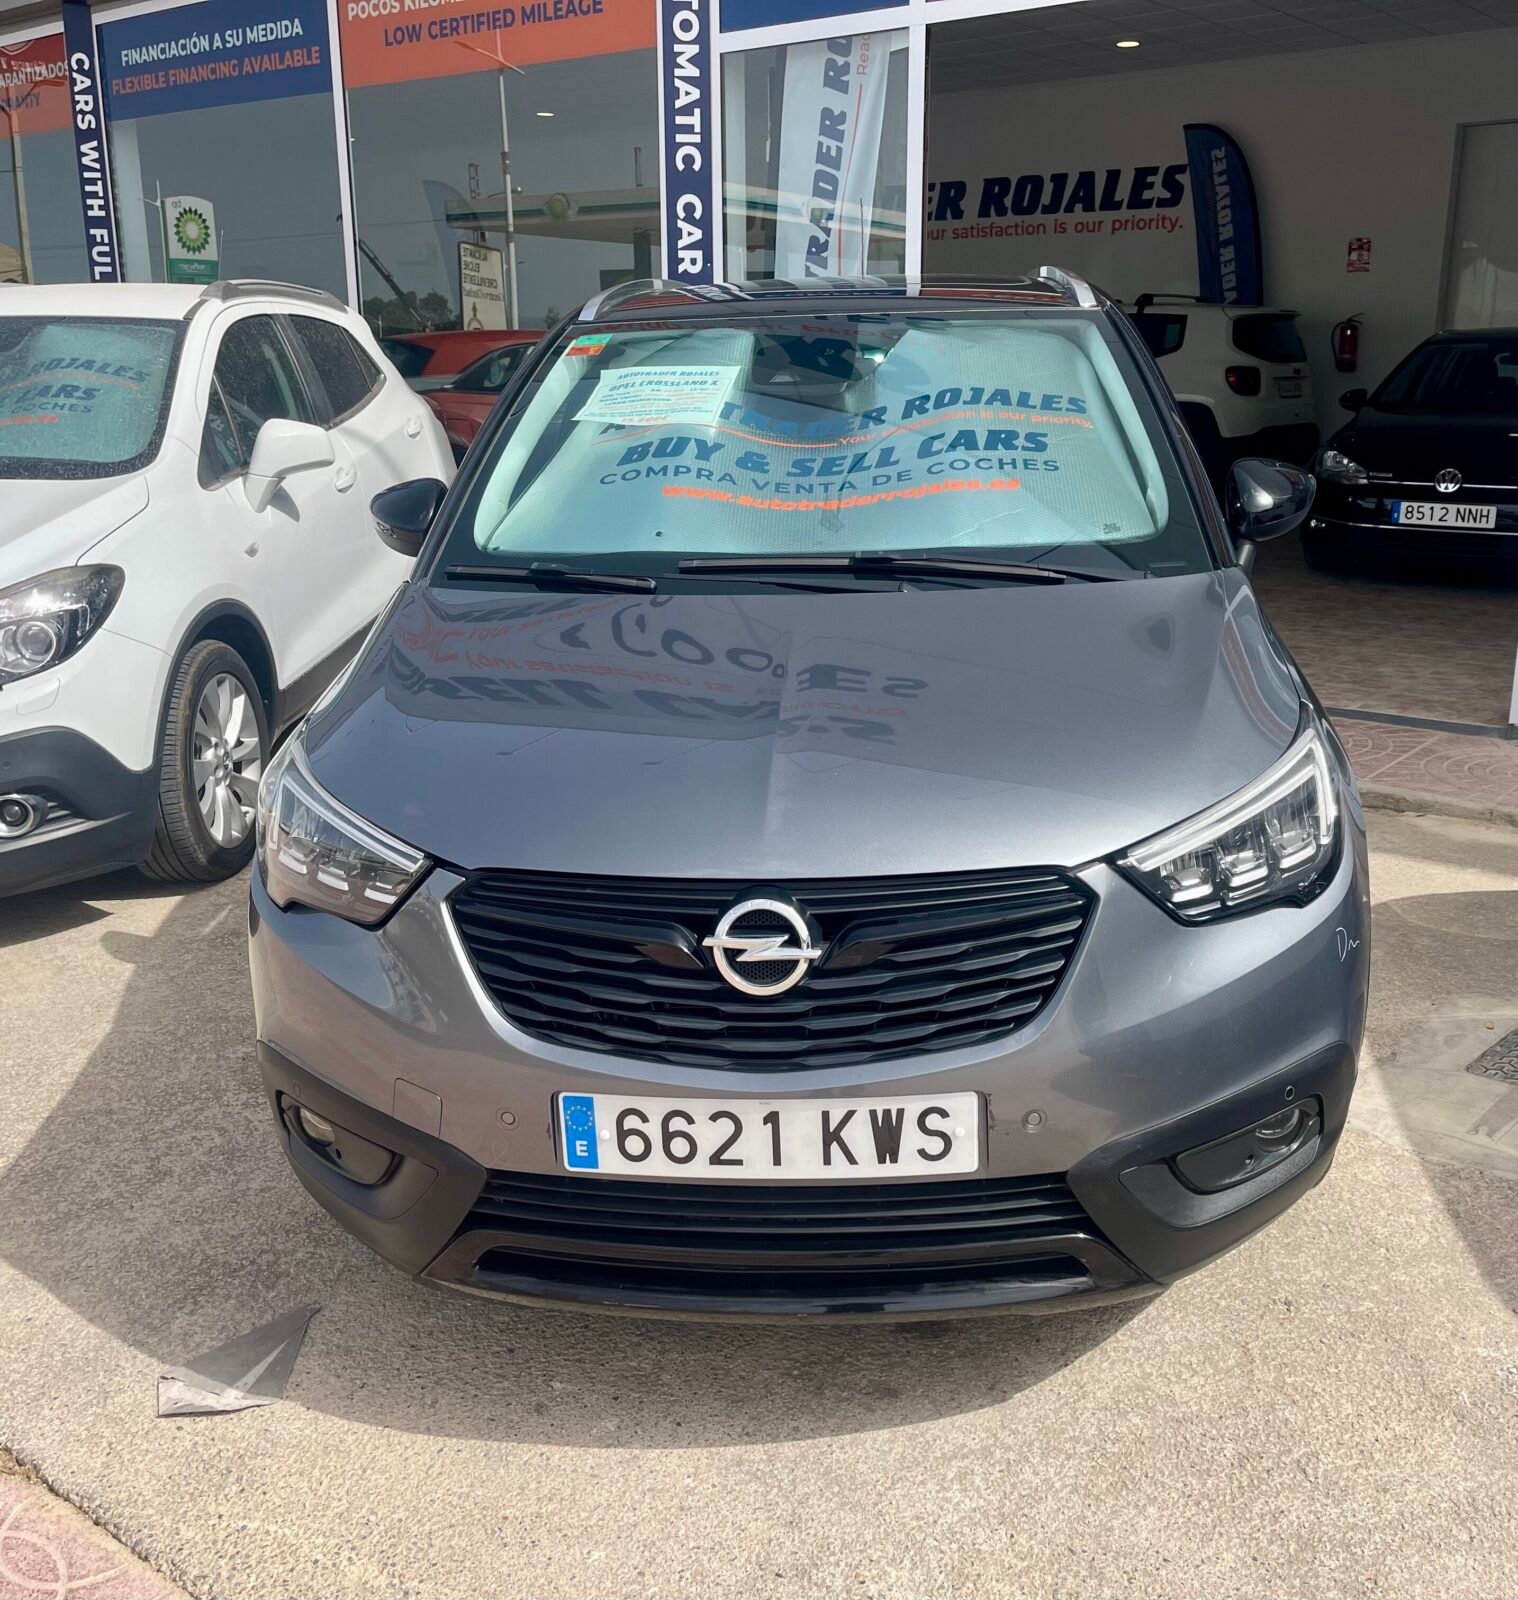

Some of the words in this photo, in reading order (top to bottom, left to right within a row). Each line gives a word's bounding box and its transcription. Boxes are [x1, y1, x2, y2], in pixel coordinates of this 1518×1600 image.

[120, 33, 208, 67] FINANCIACIÓN
[212, 36, 223, 50] A
[225, 28, 243, 47] SU
[247, 18, 304, 43] MEDIDA
[384, 23, 422, 47] LOW
[427, 8, 516, 40] CERTIFIED
[520, 0, 604, 26] MILEAGE
[70, 52, 97, 130] CARS
[111, 72, 167, 96] FLEXIBLE
[168, 60, 239, 87] FINANCING
[242, 46, 322, 75] AVAILABLE
[79, 139, 107, 218] WITH
[977, 164, 1188, 219] ROJALES
[676, 193, 704, 275] CAR
[951, 217, 1047, 240] satisfaction
[1053, 218, 1067, 235] is
[1074, 220, 1105, 235] our
[1111, 212, 1184, 236] priority.
[900, 387, 1088, 421] ROJALES
[599, 464, 738, 486] COMPRA
[751, 477, 859, 495] VENTA
[871, 469, 913, 487] DE
[926, 456, 1061, 476] COCHES
[616, 436, 726, 467] BUY
[736, 450, 771, 475] &
[786, 445, 901, 478] SELL
[916, 428, 1050, 460] CARS
[1403, 503, 1450, 523] 8512
[1454, 505, 1491, 526] NNH
[575, 1140, 588, 1157] E
[615, 1107, 782, 1167] 6621
[820, 1105, 953, 1167] KWS
